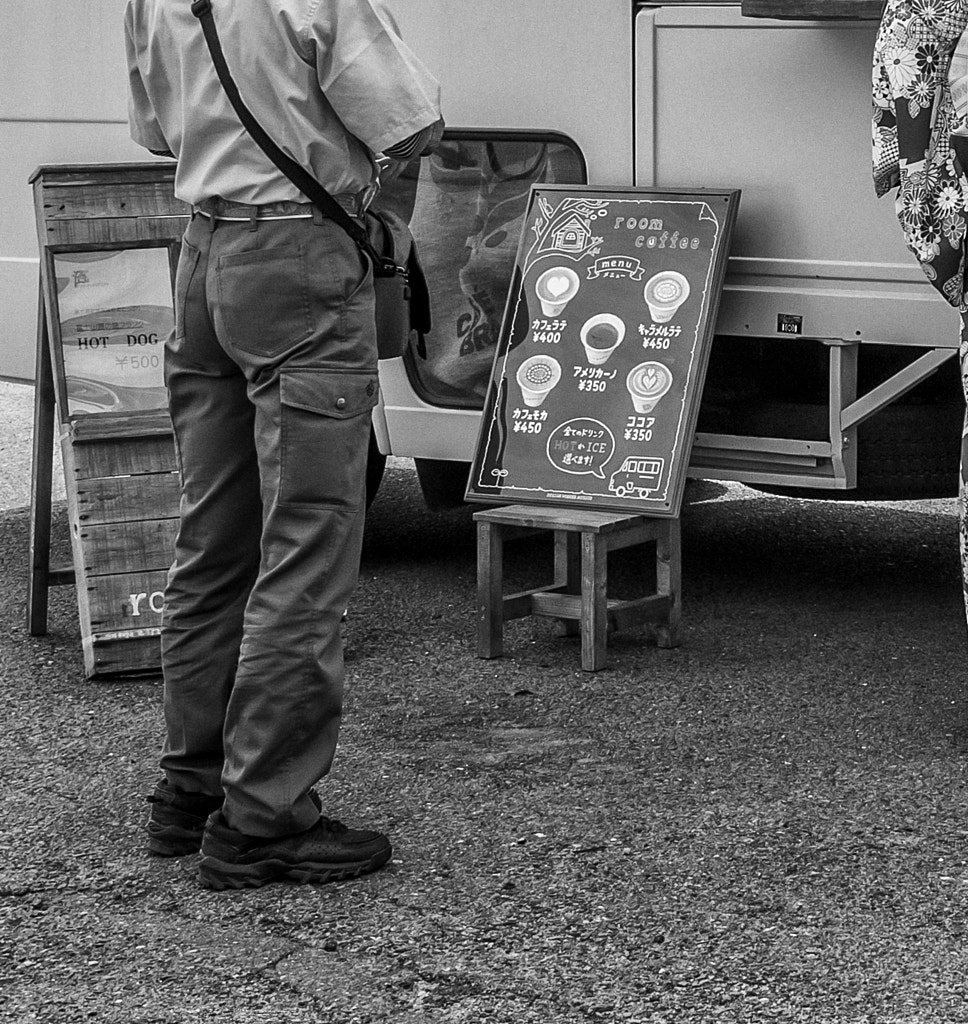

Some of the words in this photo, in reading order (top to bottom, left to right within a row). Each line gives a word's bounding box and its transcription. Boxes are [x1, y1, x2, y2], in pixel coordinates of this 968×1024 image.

[614, 217, 663, 230] room
[635, 231, 700, 249] coffee
[601, 260, 633, 269] menu
[531, 319, 567, 331] カフェラテ
[638, 324, 682, 337] キャラメルラテ
[77, 337, 109, 350] HOT
[126, 333, 158, 347] DOG
[532, 332, 561, 343] ¥400
[642, 337, 670, 349] ¥450
[115, 355, 160, 370] ¥500
[573, 366, 617, 379] アメリカーノ
[578, 379, 606, 392] ¥350
[512, 408, 548, 421] カフェモカ
[512, 421, 542, 433] ¥450
[626, 416, 655, 428] ココア
[563, 426, 604, 438] 全てのドリンク
[624, 428, 652, 441] ¥350
[554, 440, 577, 451] HOT
[586, 441, 607, 453] ICE
